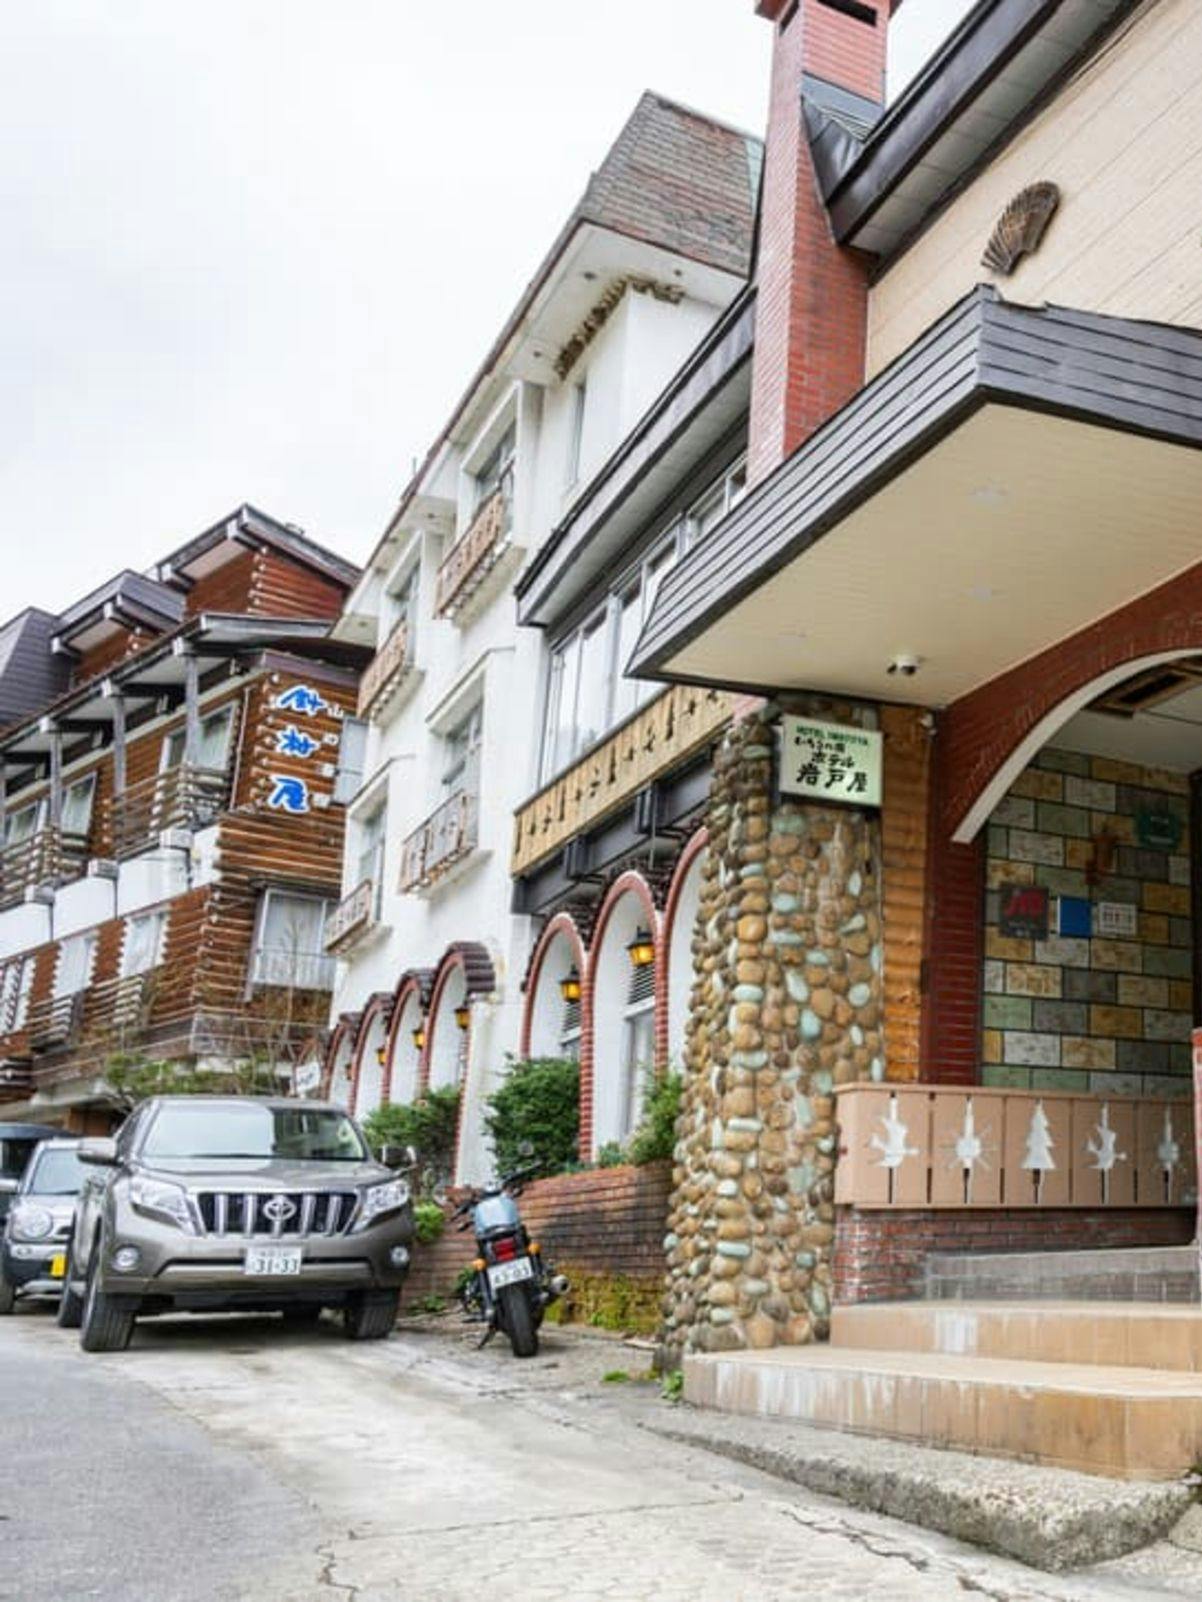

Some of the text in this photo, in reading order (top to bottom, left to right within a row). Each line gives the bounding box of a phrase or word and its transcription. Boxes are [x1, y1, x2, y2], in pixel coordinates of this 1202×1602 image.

[811, 751, 855, 769] ホテル
[796, 763, 868, 792] 岩戸屋
